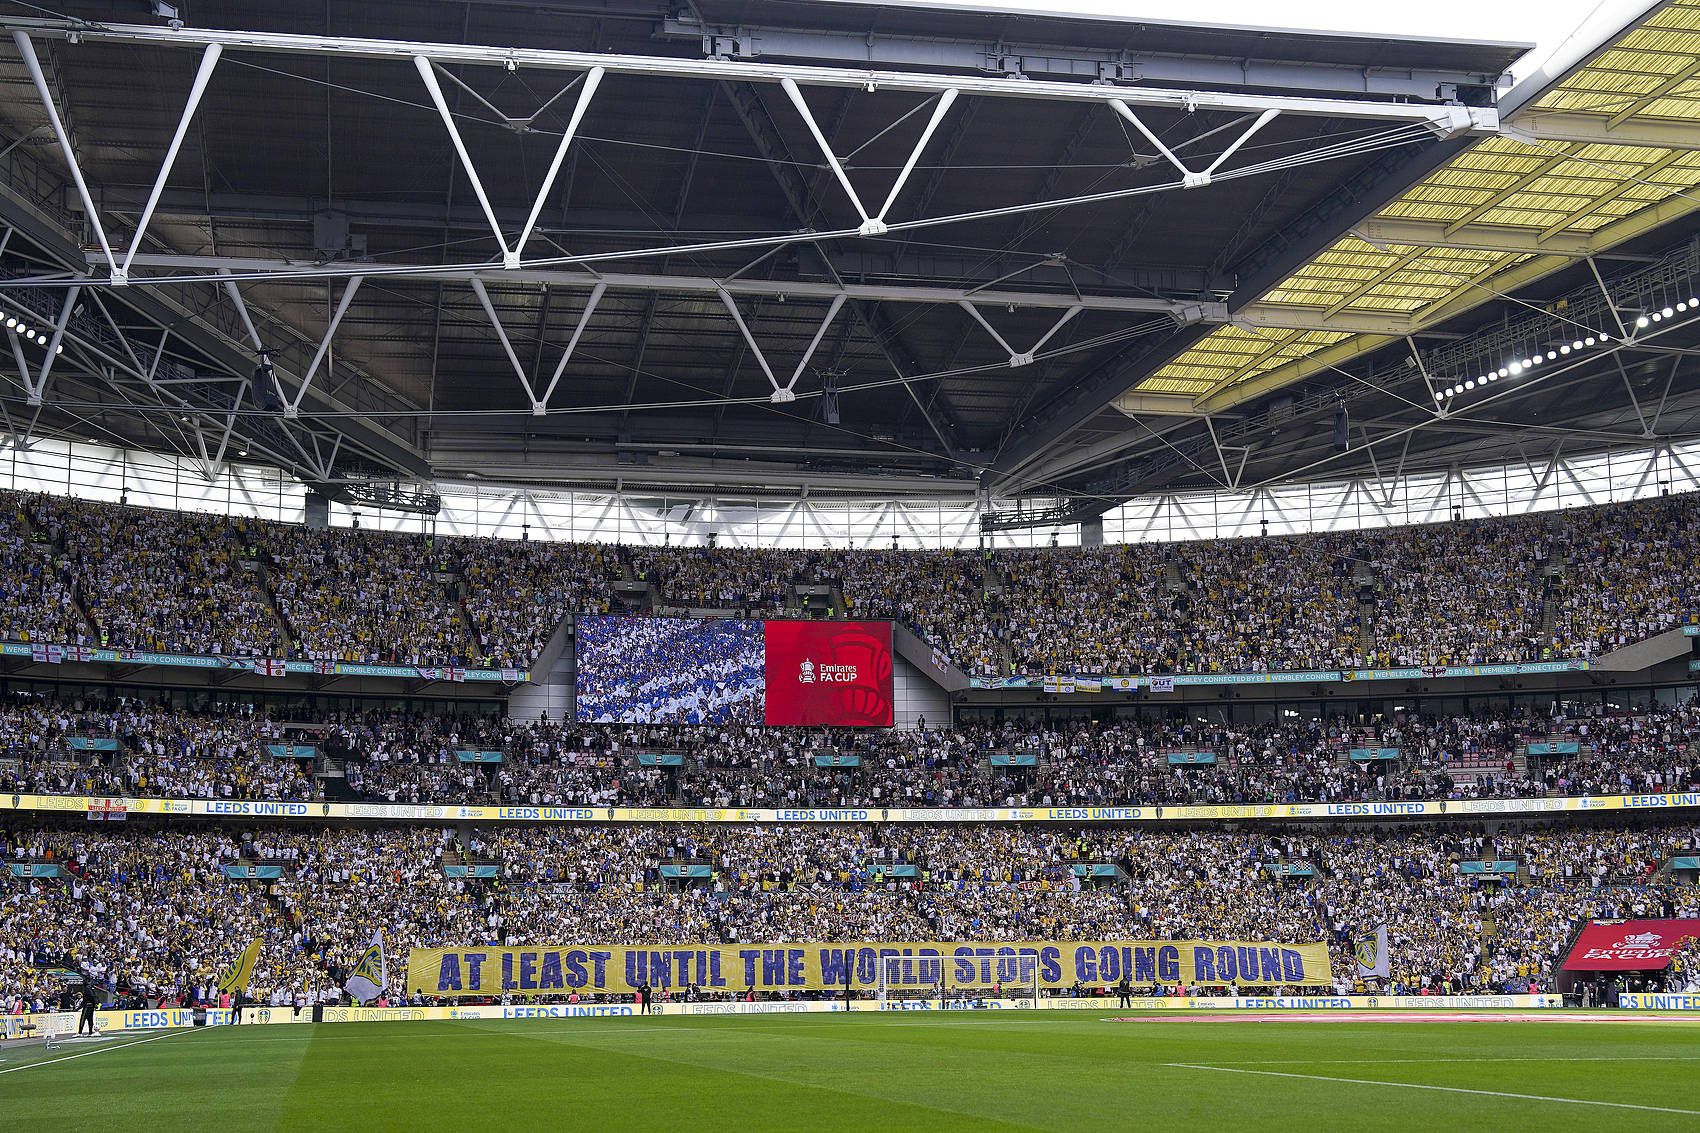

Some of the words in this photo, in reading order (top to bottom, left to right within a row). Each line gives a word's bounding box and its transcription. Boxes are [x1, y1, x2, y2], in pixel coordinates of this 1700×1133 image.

[160, 656, 206, 665] CONNECTED
[342, 666, 376, 674] WEMBLEY
[820, 663, 857, 673] Emirates
[1481, 666, 1515, 674] WEMBLEY
[1519, 664, 1562, 672] ONNECTED
[820, 673, 833, 682] FA
[835, 673, 857, 682] CUP
[1203, 675, 1246, 683] CONNECTED
[1272, 673, 1305, 681] WEMBLEY
[1305, 672, 1339, 680] CONNECT
[37, 797, 84, 810] LEEDS
[1462, 801, 1506, 812] LEEDS
[1508, 799, 1563, 811] UNITED
[1623, 796, 1667, 808] LEEDS
[206, 802, 249, 814] LEEDS
[255, 803, 307, 815] UNITED
[344, 805, 387, 817] LEEDS
[391, 806, 443, 817] UNITED
[499, 808, 540, 819] LEEDS
[544, 808, 593, 819] UNITED
[1049, 809, 1088, 819] LEEDS
[1092, 808, 1141, 819] UNITED
[1177, 806, 1218, 817] LEEDS
[1221, 806, 1272, 816] UNITED
[1328, 804, 1369, 815] LEEDS
[1374, 803, 1425, 814] UNITED
[628, 810, 669, 820] LEEDS
[673, 810, 722, 820] UNITED
[776, 810, 815, 821] LEEDS
[820, 810, 867, 821] UNITED
[902, 810, 943, 820] LEEDS
[946, 810, 995, 820] UNITED
[1617, 952, 1671, 960] CUP
[437, 953, 486, 991] AT
[501, 950, 611, 990] LEAST
[625, 950, 726, 988] UNTIL
[739, 949, 806, 987] THE
[820, 947, 940, 986] WORLD
[954, 946, 1061, 983] STOPS
[1074, 945, 1180, 983] GOING
[1193, 945, 1305, 983] ROUND
[1047, 1000, 1099, 1009] LEEDS
[1235, 999, 1285, 1009] LEEDS
[1290, 998, 1352, 1008] UNITED
[1394, 997, 1446, 1008] LEEDS
[1449, 997, 1515, 1008] UNITED
[503, 1007, 559, 1019] LEEDS
[565, 1006, 633, 1018] UNITED
[681, 1003, 737, 1016] LEEDS
[741, 1003, 808, 1014] UNITED
[124, 1011, 168, 1028] LEEDS
[290, 1008, 349, 1023] LEDS
[353, 1009, 425, 1022] UNITED
